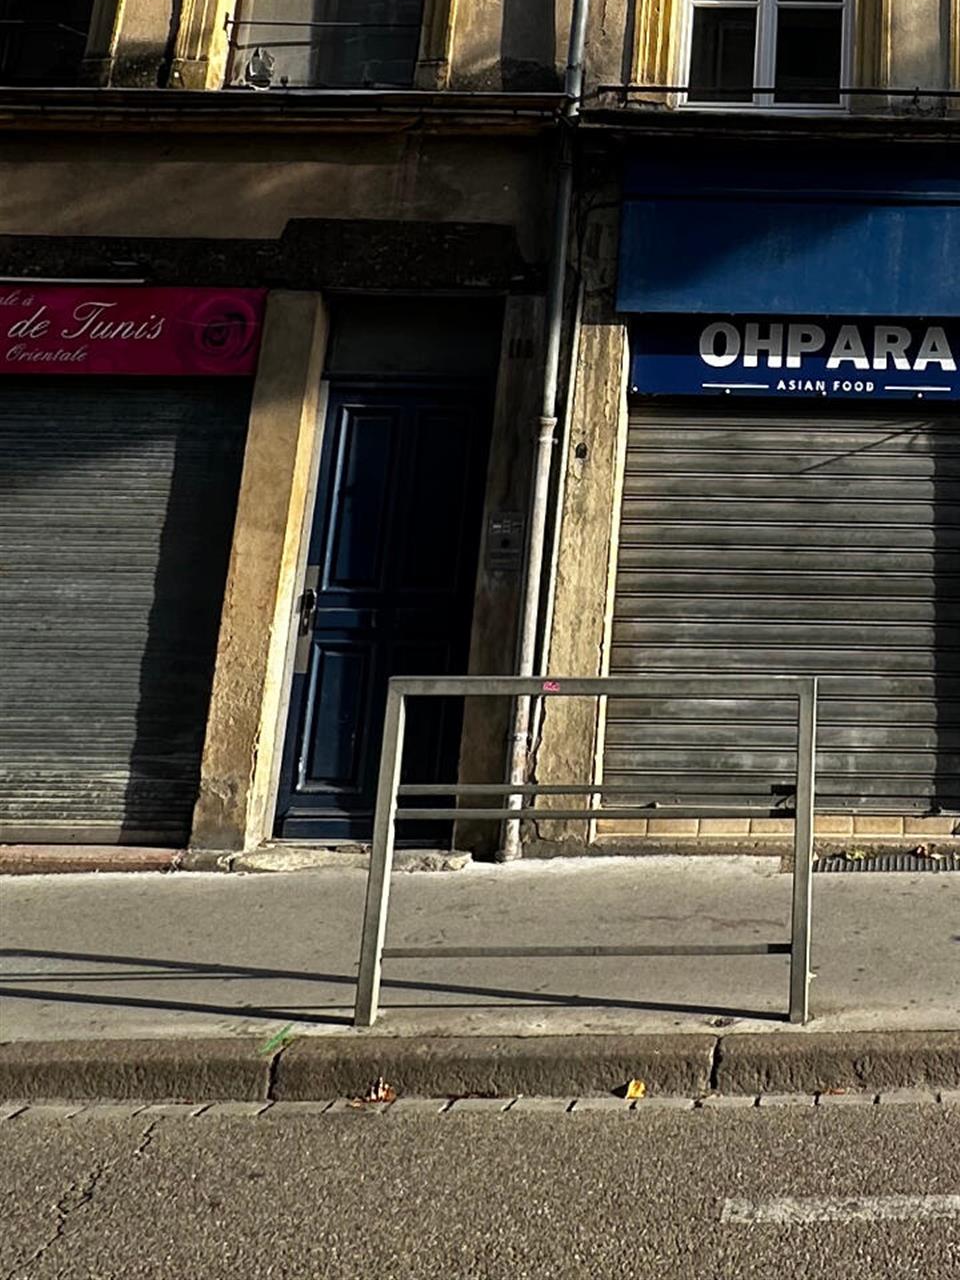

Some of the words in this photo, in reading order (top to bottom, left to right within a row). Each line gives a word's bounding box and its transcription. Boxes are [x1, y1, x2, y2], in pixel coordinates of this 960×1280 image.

[7, 305, 51, 339] de
[60, 301, 166, 340] Tunis
[5, 342, 88, 363] Orientale
[699, 322, 957, 371] OHPARA
[776, 379, 826, 393] ASIAN
[832, 380, 875, 393] FOOD
